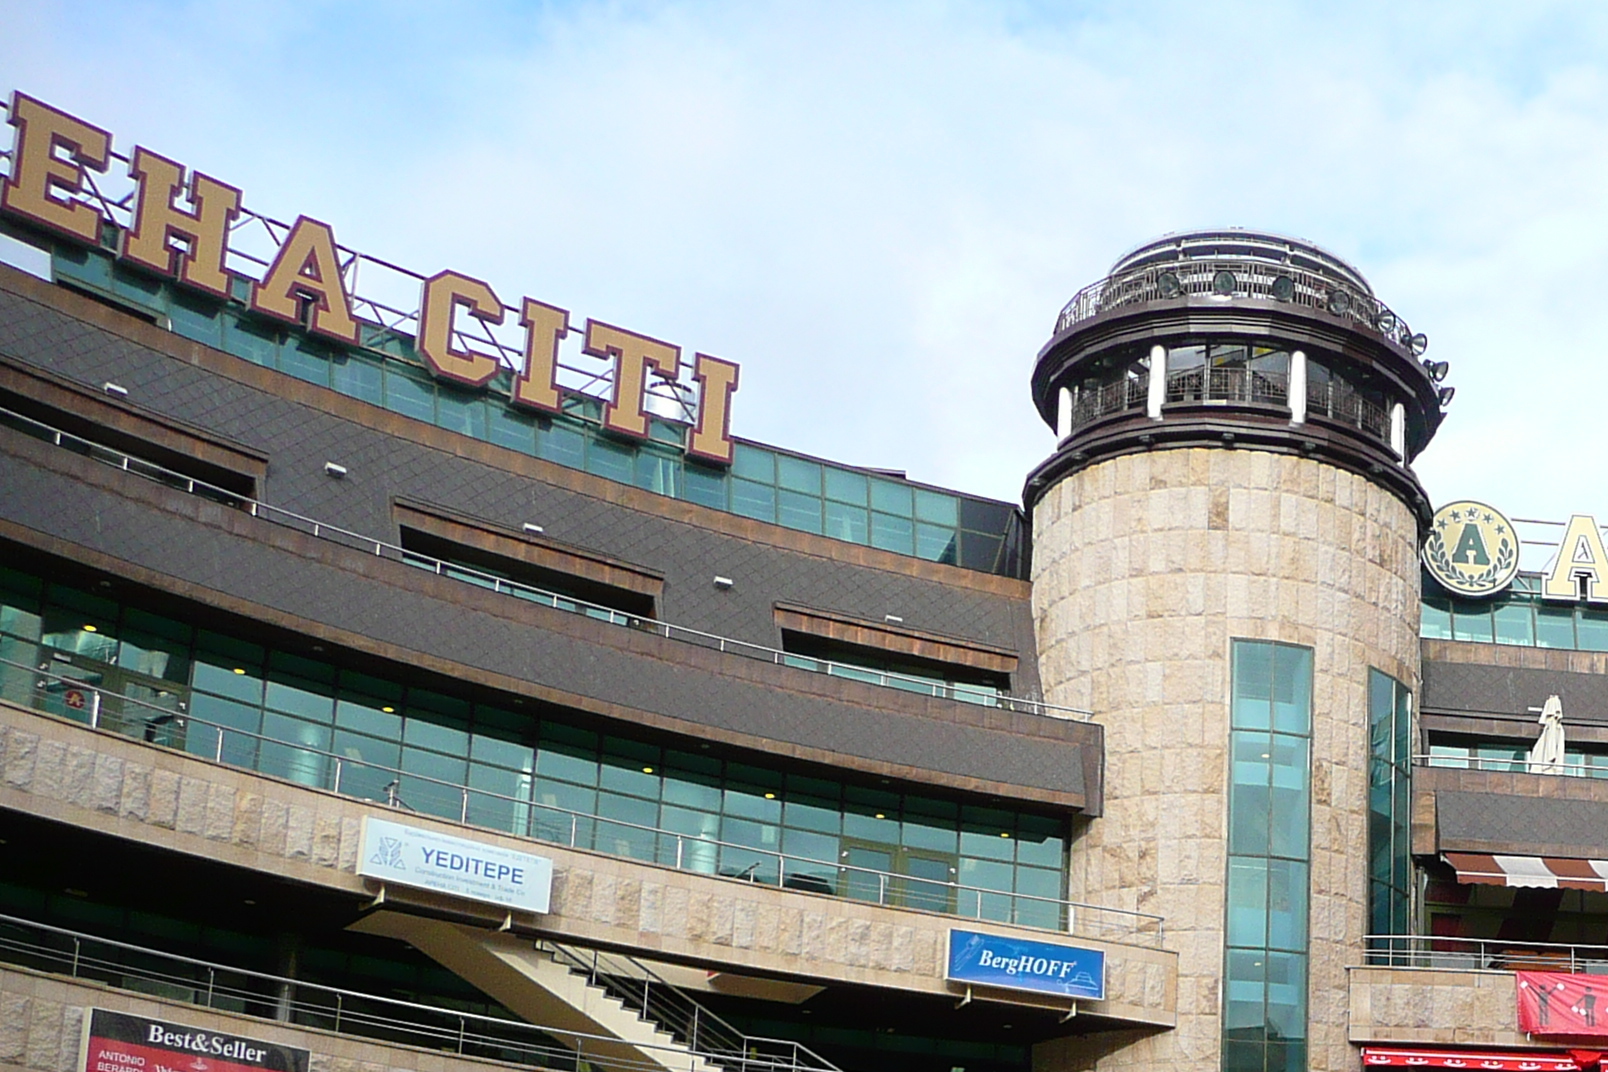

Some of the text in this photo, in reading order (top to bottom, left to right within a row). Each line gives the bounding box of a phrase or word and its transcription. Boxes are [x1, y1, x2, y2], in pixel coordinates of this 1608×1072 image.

[422, 847, 524, 884] YEDITEPE
[979, 950, 1074, 979] BergHOFF
[99, 1050, 145, 1066] ANTONIO
[148, 1024, 267, 1062] Best&Seller
